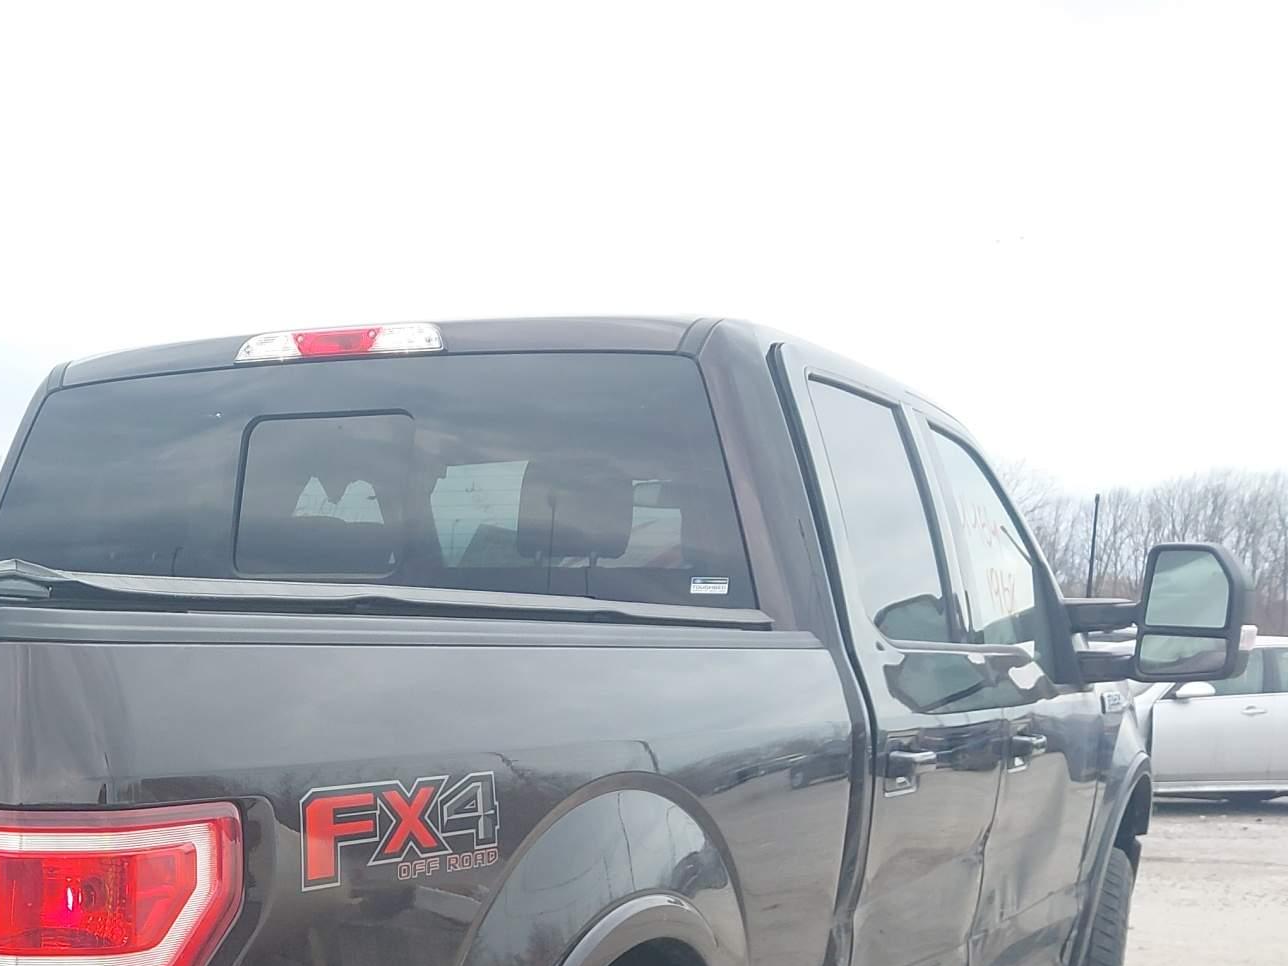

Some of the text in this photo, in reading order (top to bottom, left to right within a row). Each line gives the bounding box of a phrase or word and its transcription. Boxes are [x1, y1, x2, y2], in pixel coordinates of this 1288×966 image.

[300, 771, 500, 892] FX4
[397, 848, 499, 880] OFF ROAD
